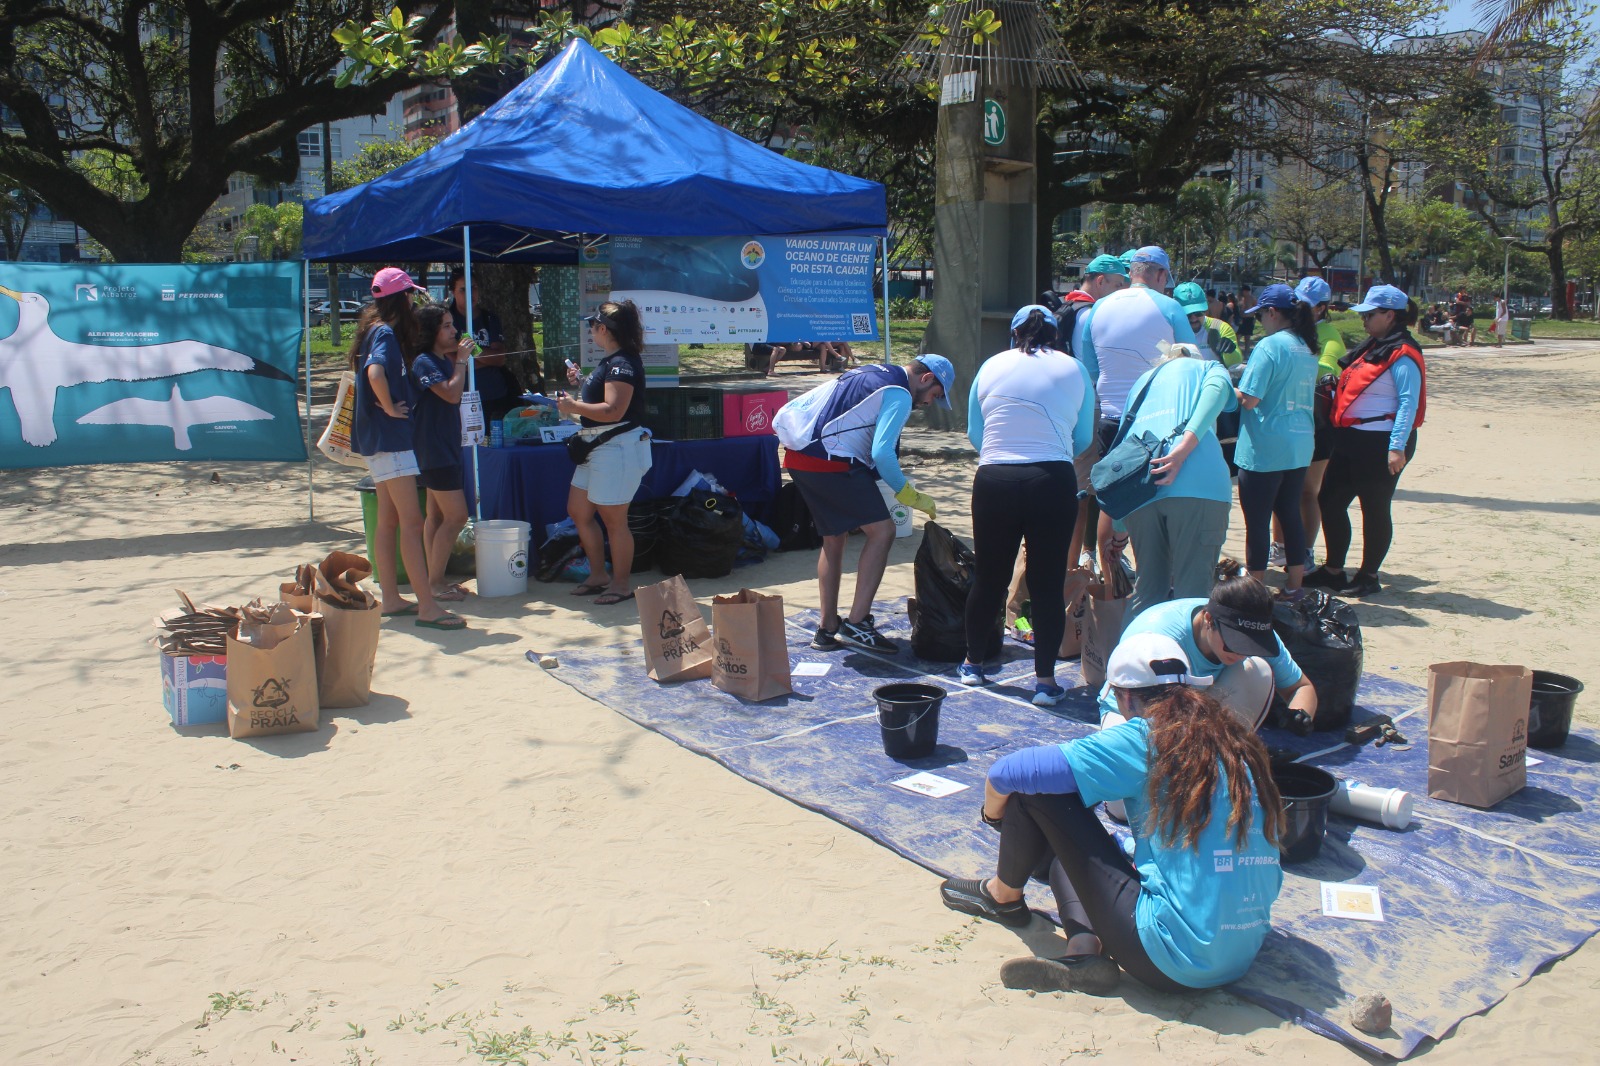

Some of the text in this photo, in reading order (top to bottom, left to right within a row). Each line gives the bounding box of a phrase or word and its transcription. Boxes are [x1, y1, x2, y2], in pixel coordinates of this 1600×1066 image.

[786, 238, 872, 253] VAMOS JUNTAR UM
[785, 251, 870, 264] OCEANO DE GENTE
[790, 264, 868, 275] POR ESTA CAUSA!
[661, 633, 696, 651] RECICLA
[663, 640, 700, 661] PRAIA
[251, 705, 297, 718] RECICLA
[251, 714, 300, 728] PRAIA
